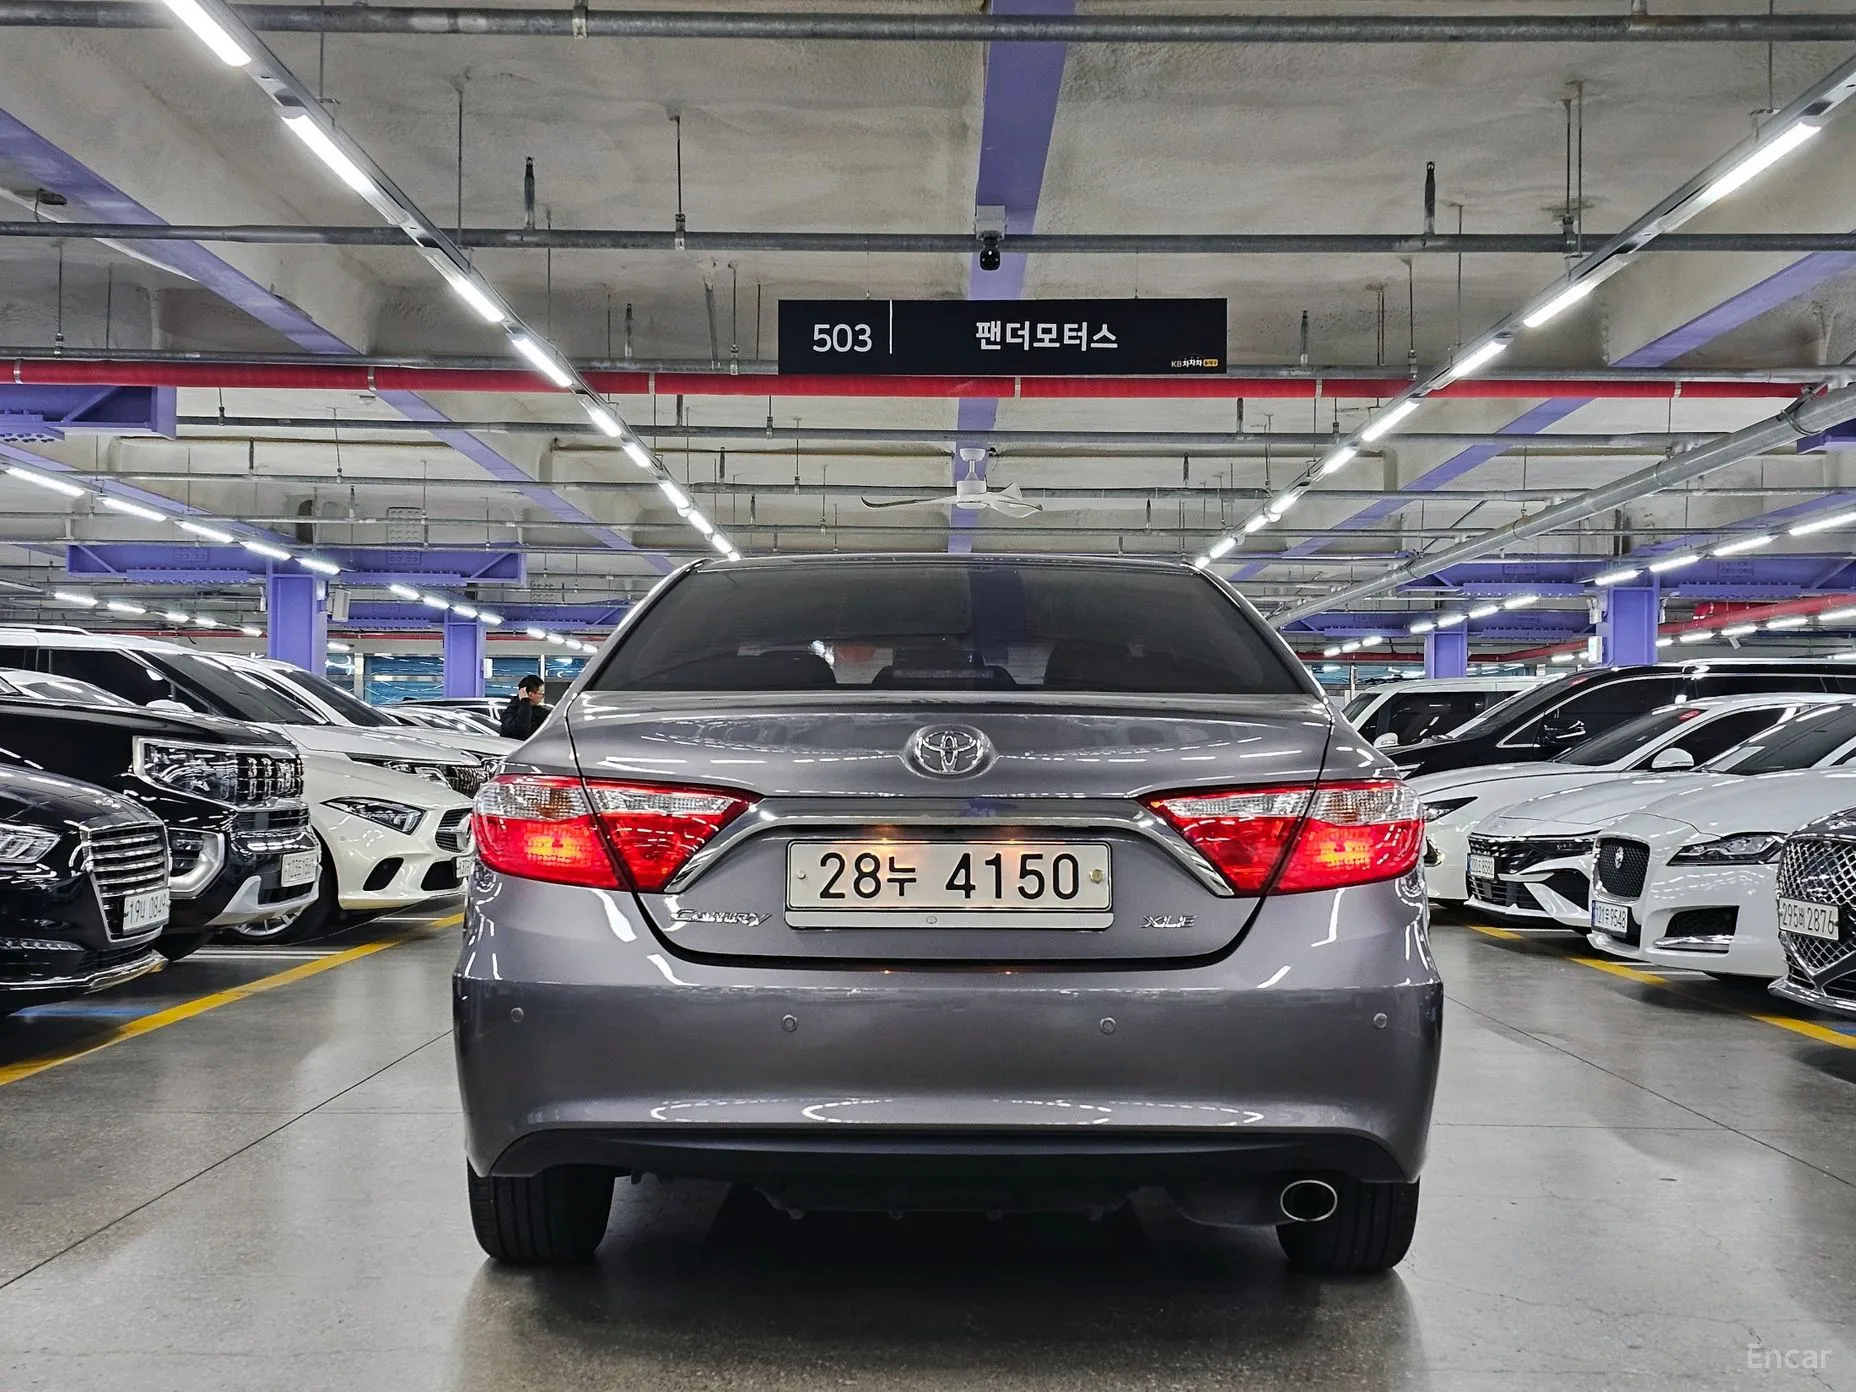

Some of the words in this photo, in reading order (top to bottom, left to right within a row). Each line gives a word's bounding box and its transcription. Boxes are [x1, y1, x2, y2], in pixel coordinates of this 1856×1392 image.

[812, 323, 873, 353] 503
[976, 320, 1119, 352] 팬더모터스
[819, 852, 917, 900] 28누
[945, 852, 1080, 901] 4150
[1140, 915, 1198, 929] XLE
